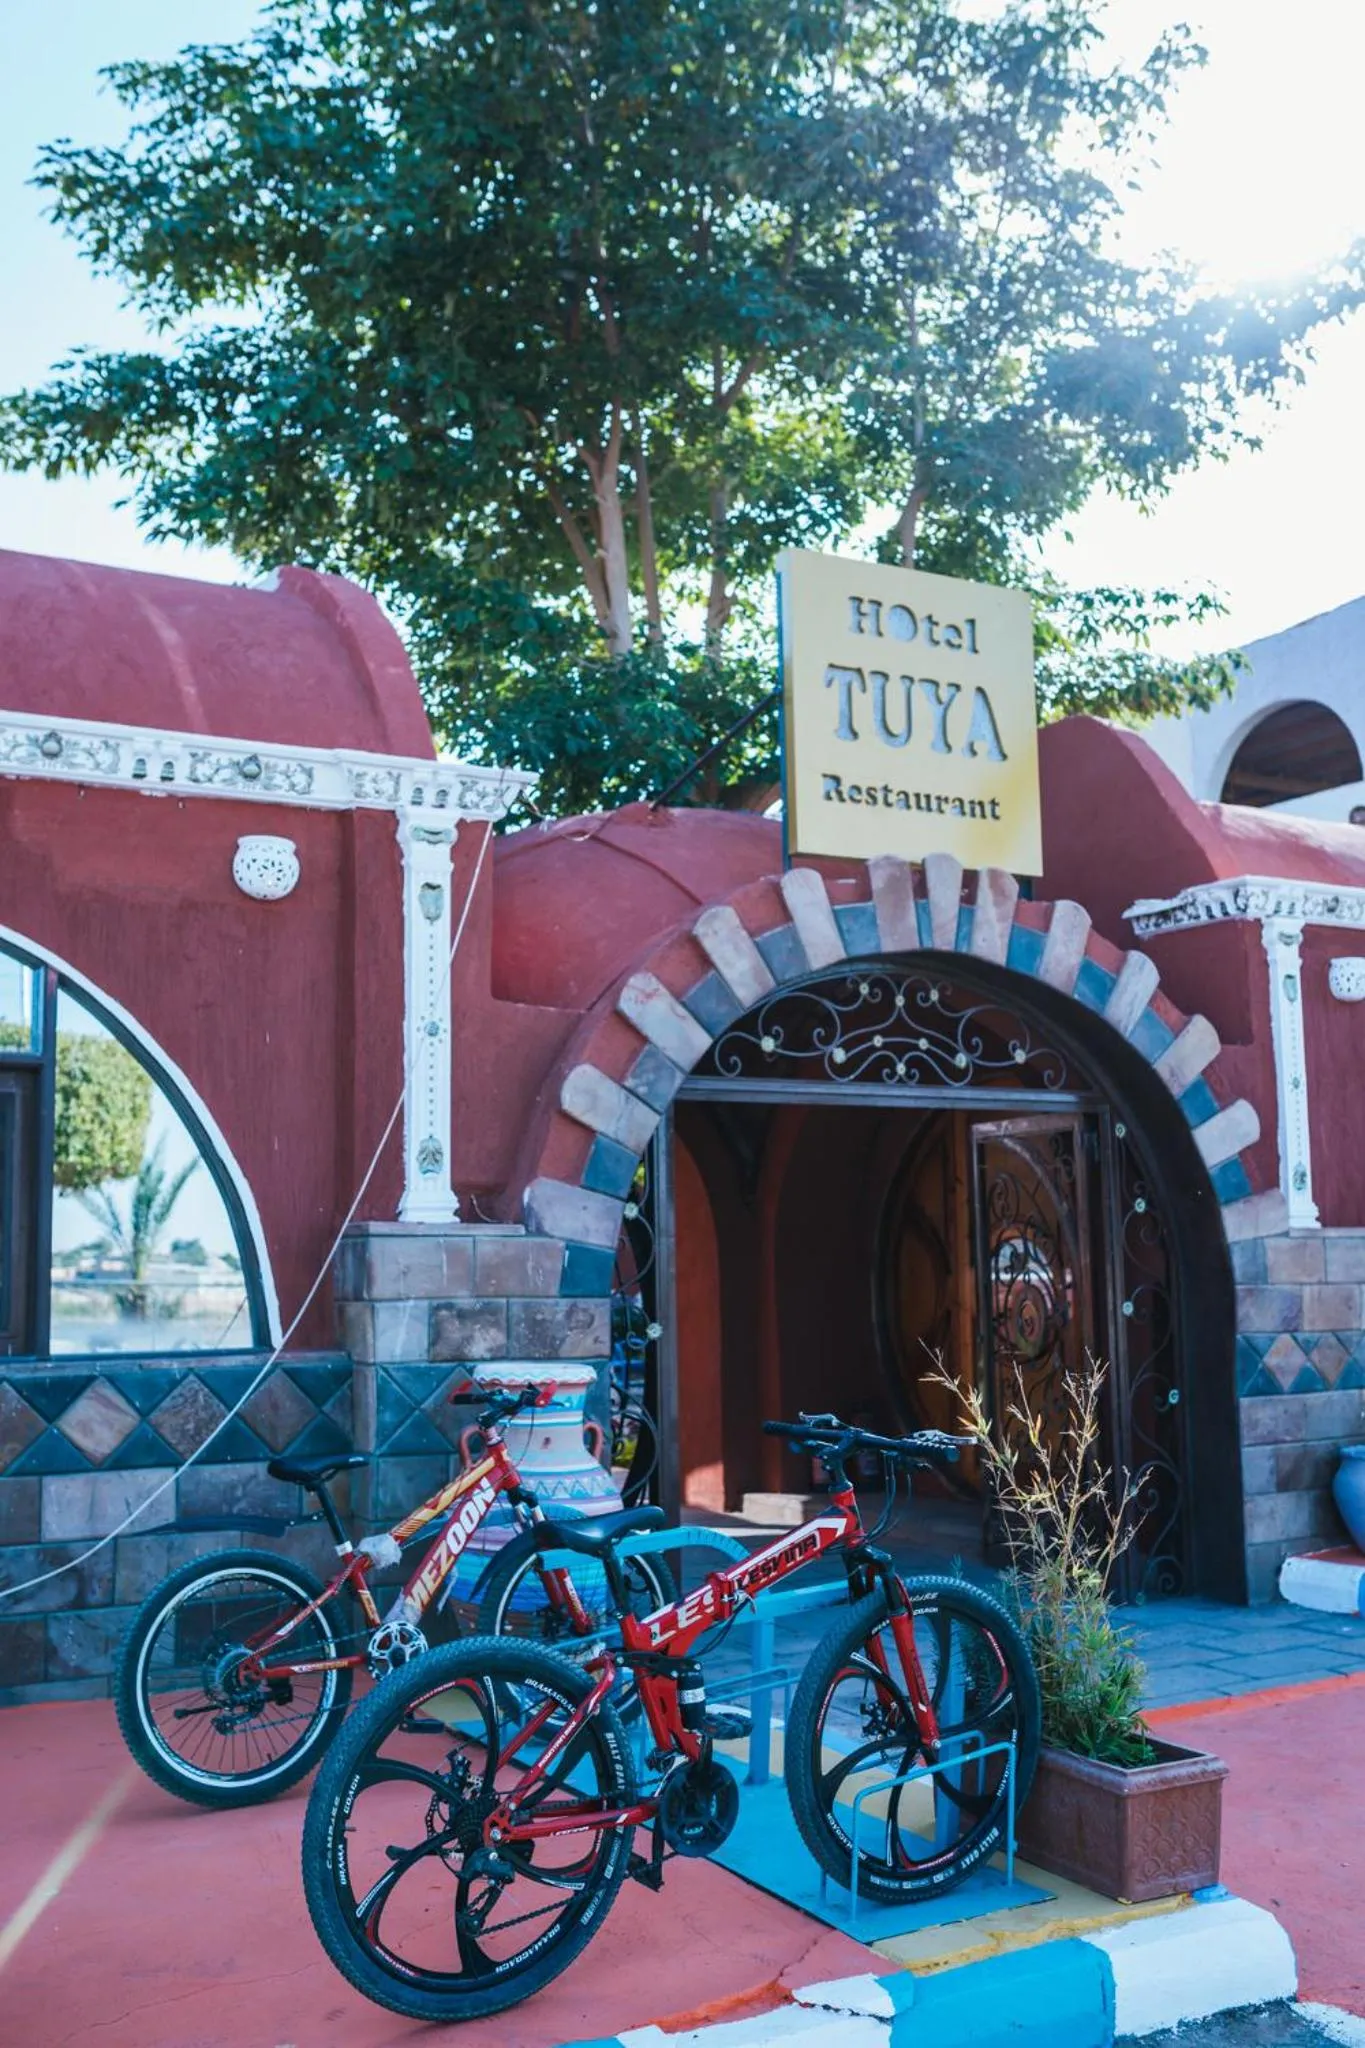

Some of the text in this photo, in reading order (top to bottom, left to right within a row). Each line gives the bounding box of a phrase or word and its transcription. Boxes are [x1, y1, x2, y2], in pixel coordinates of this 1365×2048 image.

[824, 662, 1008, 762] TUYA
[821, 772, 1002, 821] Restaurant
[404, 1476, 496, 1616] MEZOON
[604, 1731, 621, 1761] BILLY
